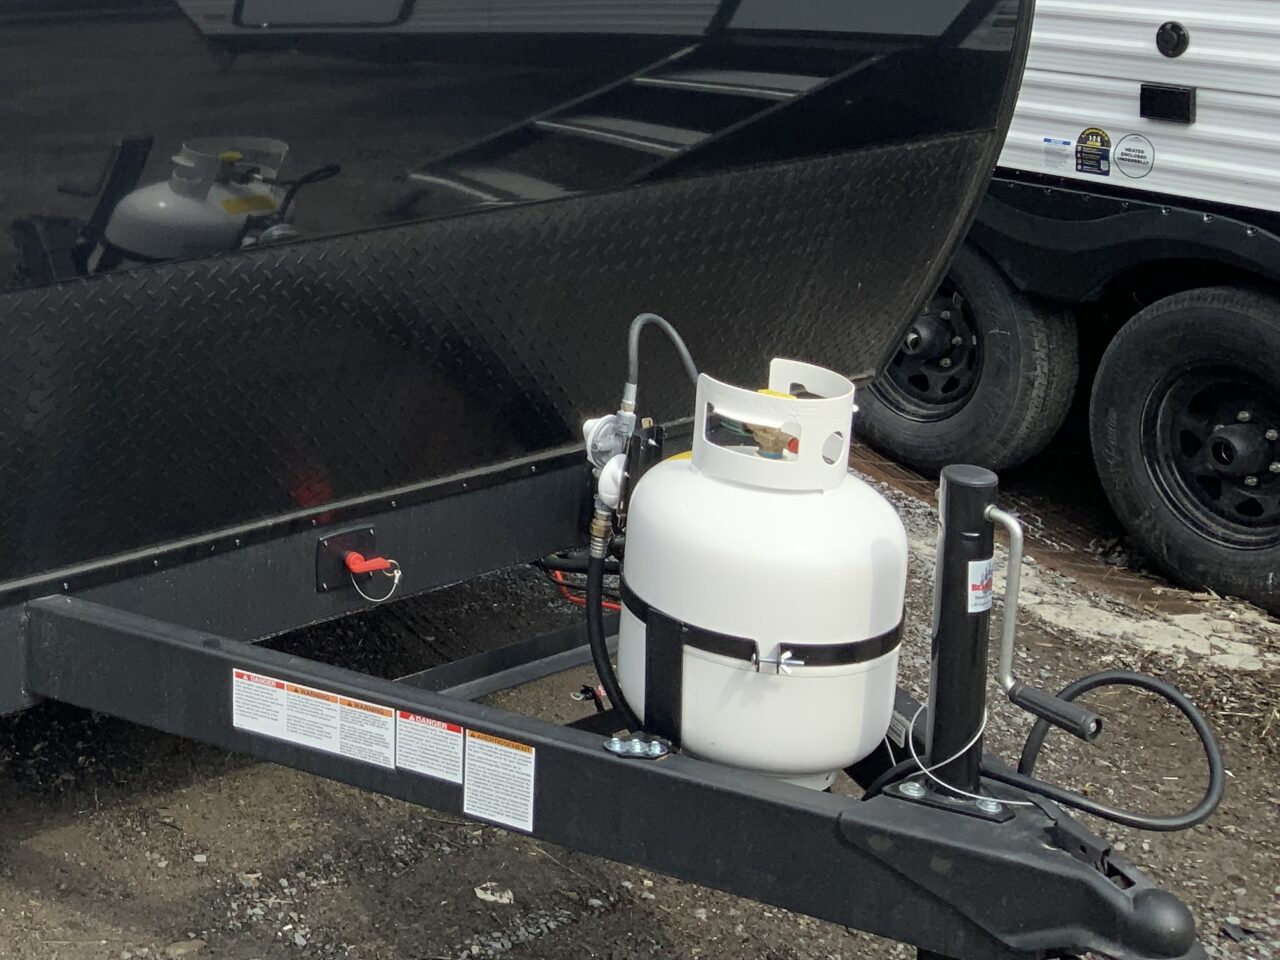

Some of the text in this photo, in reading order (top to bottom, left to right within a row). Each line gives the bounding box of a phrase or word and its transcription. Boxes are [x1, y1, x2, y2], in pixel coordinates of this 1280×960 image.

[249, 675, 277, 688] DANGER
[300, 687, 330, 702] WARNING
[353, 701, 385, 716] WARNING
[415, 715, 448, 730] DANGER
